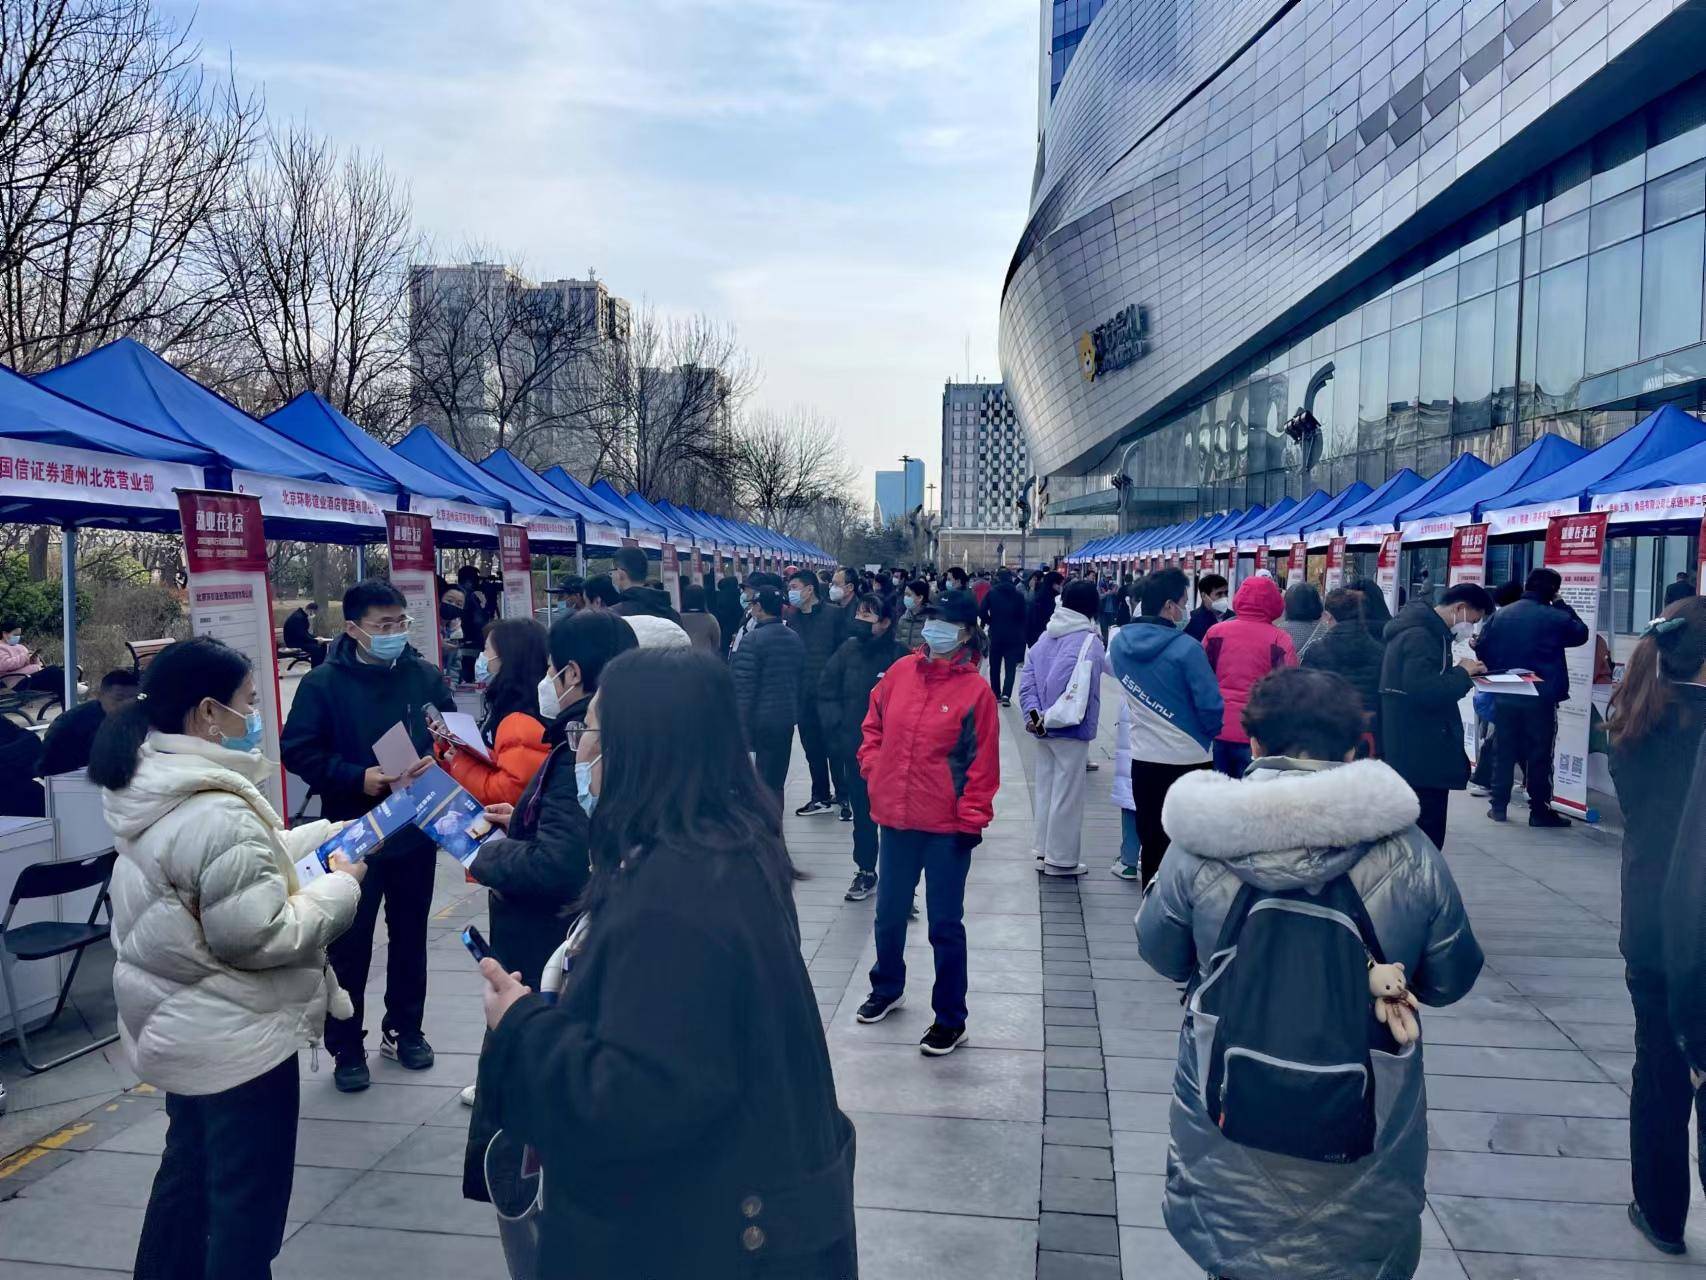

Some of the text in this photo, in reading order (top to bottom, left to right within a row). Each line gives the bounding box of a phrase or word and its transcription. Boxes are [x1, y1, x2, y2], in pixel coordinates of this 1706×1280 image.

[0, 456, 155, 493] 国信证券通州北苑营业部
